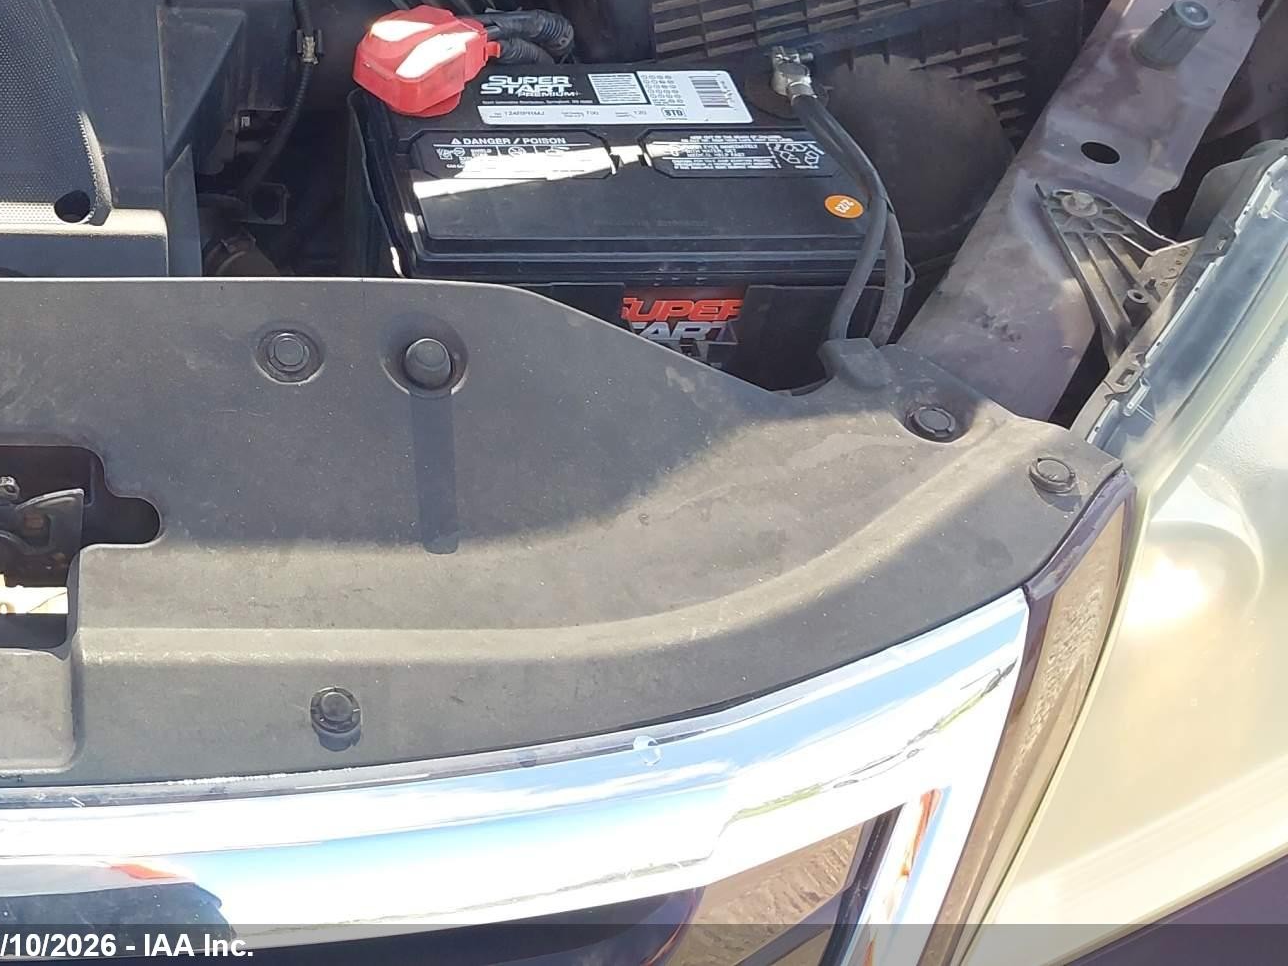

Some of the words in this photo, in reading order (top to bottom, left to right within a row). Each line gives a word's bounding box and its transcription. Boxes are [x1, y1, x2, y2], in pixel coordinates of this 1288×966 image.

[488, 75, 570, 85] SUPER
[480, 84, 573, 95] START
[461, 137, 512, 145] DANGER
[522, 137, 567, 145] POISON
